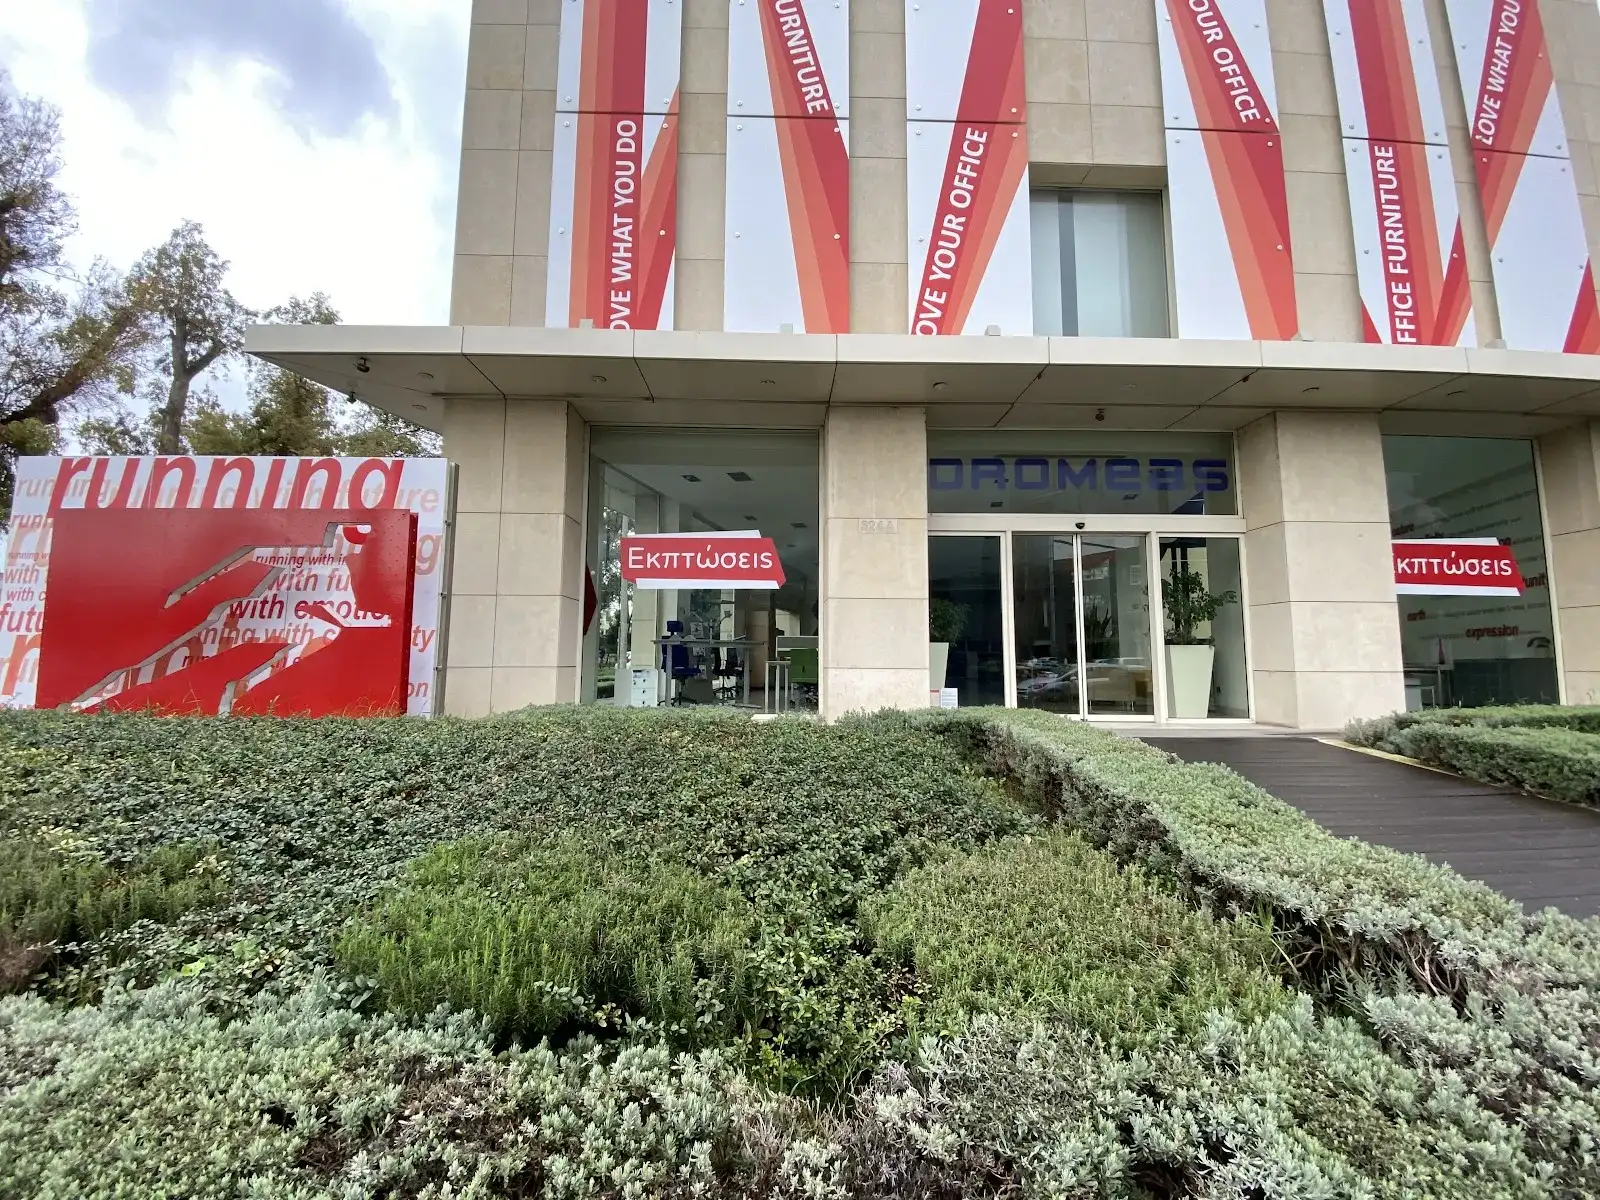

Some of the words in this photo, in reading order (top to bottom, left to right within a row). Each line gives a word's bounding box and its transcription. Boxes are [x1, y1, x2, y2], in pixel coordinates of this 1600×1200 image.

[776, 0, 829, 114] URNITURE
[1486, 36, 1512, 92] WHAT
[1213, 48, 1261, 123] OFFICE
[616, 120, 637, 153] DO
[1475, 95, 1501, 146] LOVE
[614, 160, 636, 207] YOU
[929, 214, 966, 280] YOUR
[949, 127, 988, 208] OFFICE
[1374, 146, 1409, 274] FURNITURE
[611, 213, 633, 283] WHAT
[1391, 281, 1417, 343] FFICE
[4, 563, 39, 584] with
[255, 553, 305, 568] running
[308, 553, 334, 566] with
[628, 544, 773, 570] Εκπτώσεις
[1393, 551, 1512, 576] κπτώσεις
[7, 587, 34, 602] with
[267, 567, 319, 591] with
[229, 593, 285, 619] with
[264, 622, 314, 645] with
